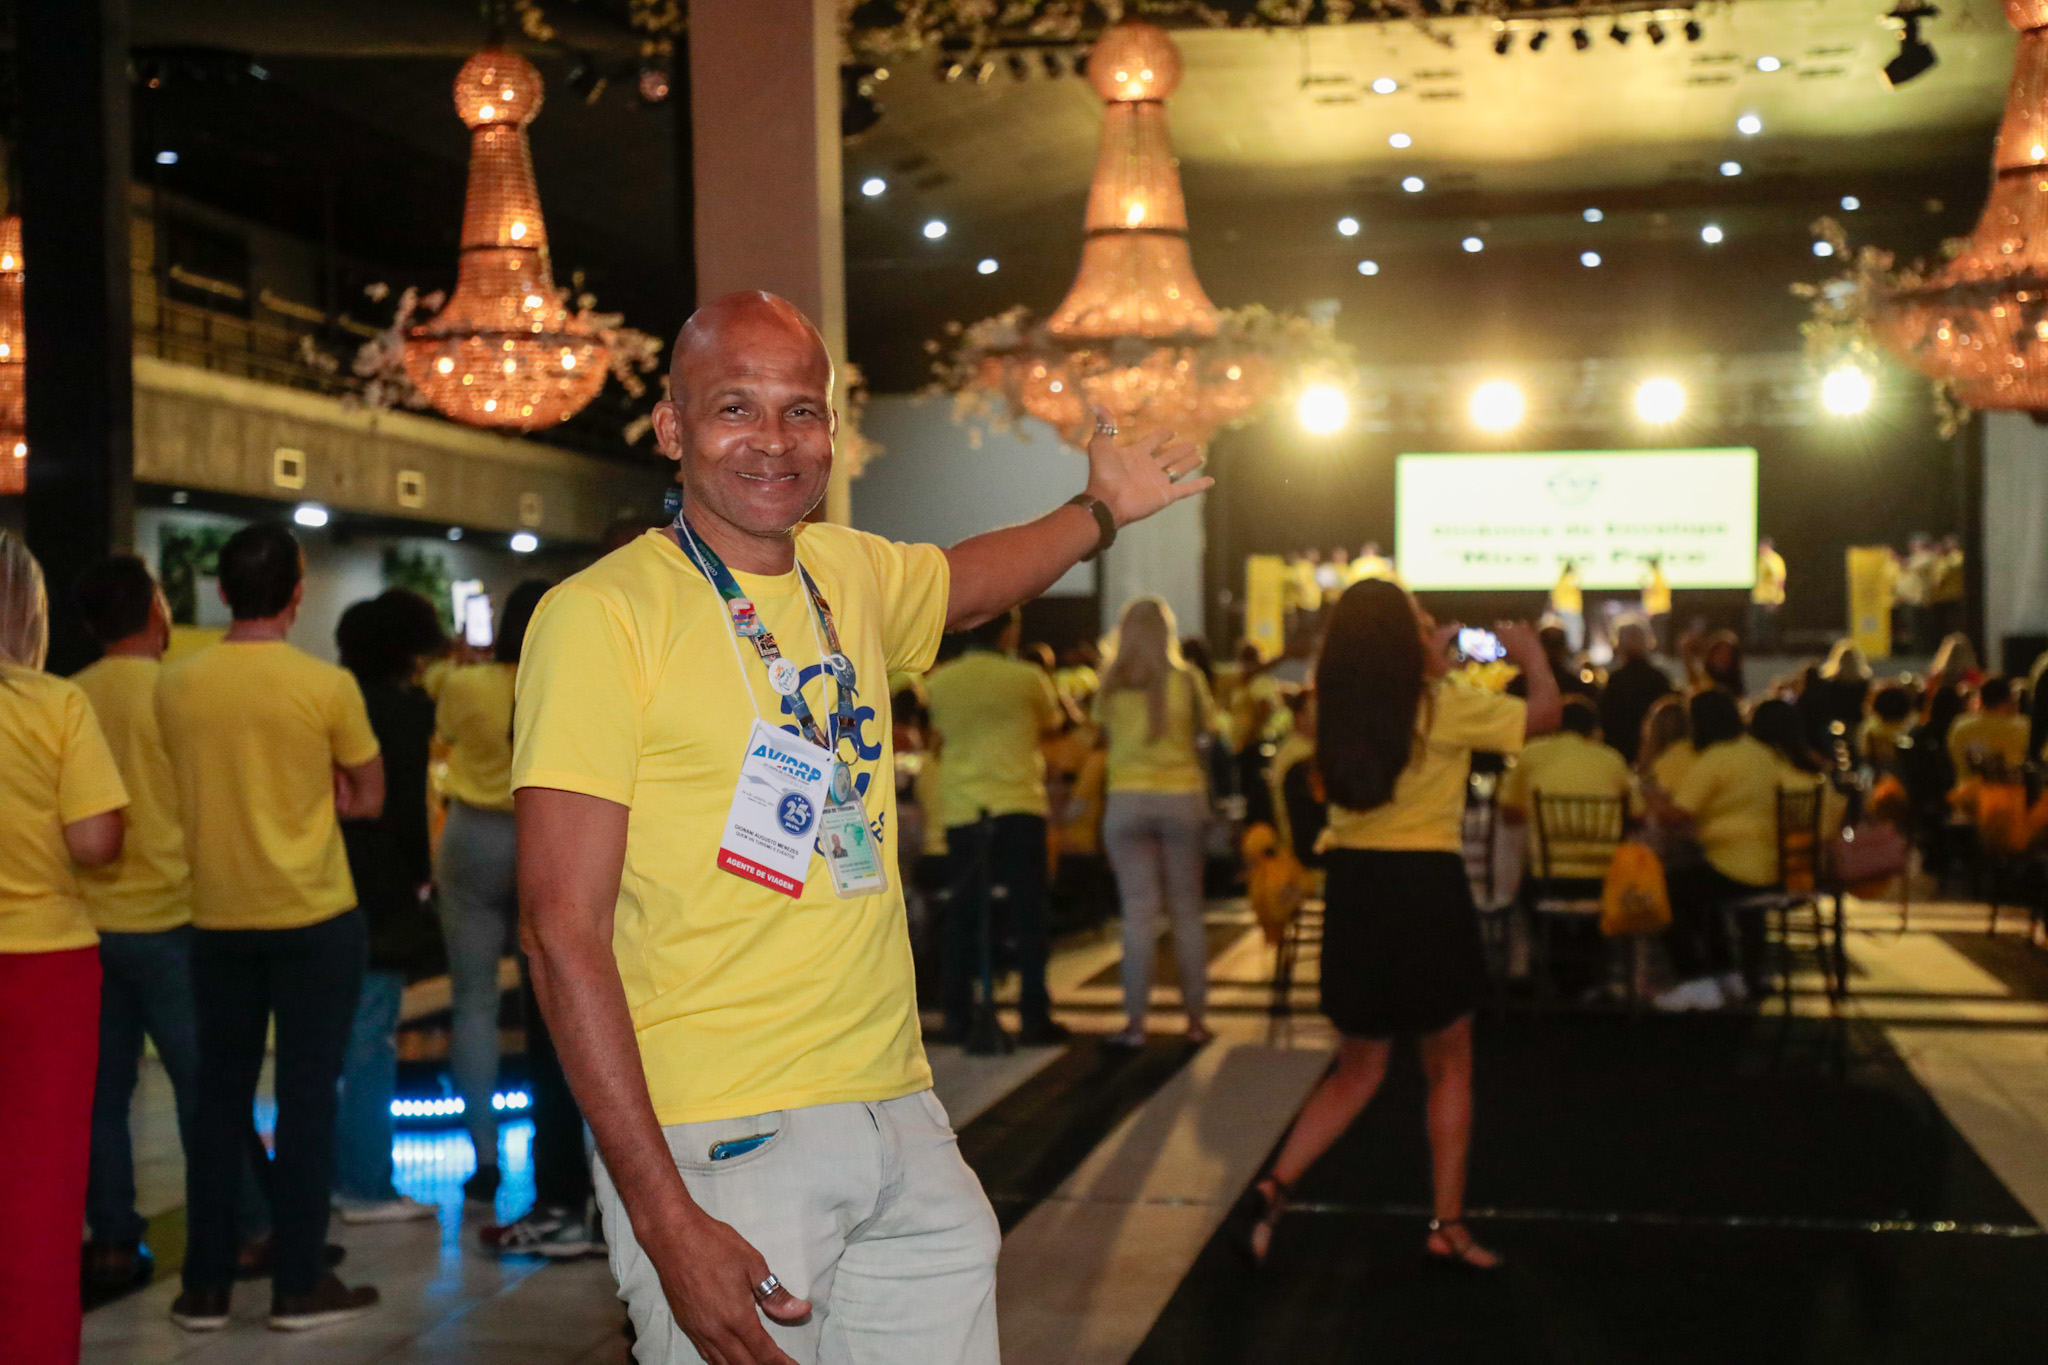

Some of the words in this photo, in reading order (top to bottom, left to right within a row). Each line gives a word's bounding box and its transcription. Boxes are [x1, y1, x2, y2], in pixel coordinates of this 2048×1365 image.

[752, 745, 822, 782] AVIRRP
[755, 833, 777, 846] AUGUSTO
[777, 842, 799, 855] MENEZES
[726, 857, 755, 874] AGENTE
[756, 869, 766, 879] DE
[767, 873, 794, 891] VIAGEM
